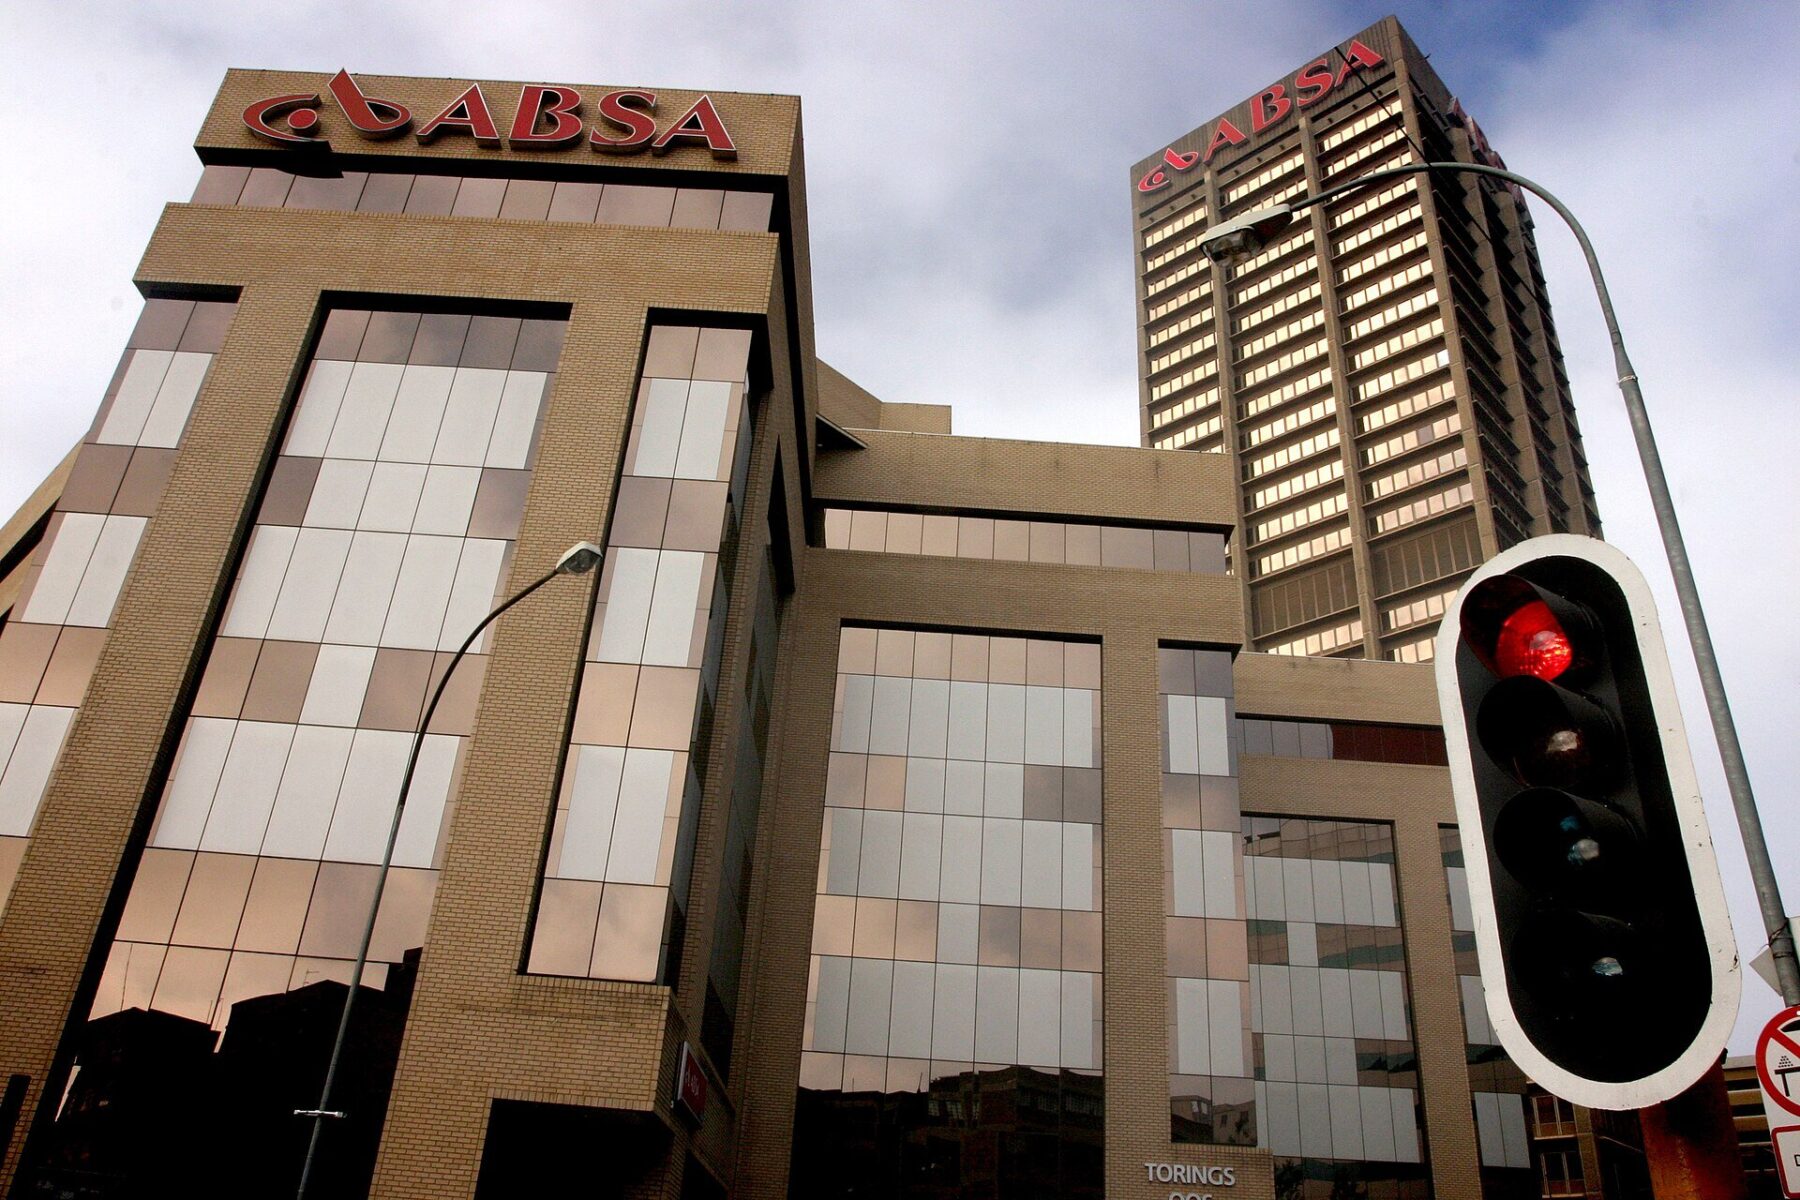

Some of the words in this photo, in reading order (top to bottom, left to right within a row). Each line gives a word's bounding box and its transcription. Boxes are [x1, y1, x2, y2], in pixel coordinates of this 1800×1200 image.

[415, 82, 738, 161] ABSA
[1203, 39, 1385, 165] ABSA
[1144, 1162, 1236, 1186] TORINGS
